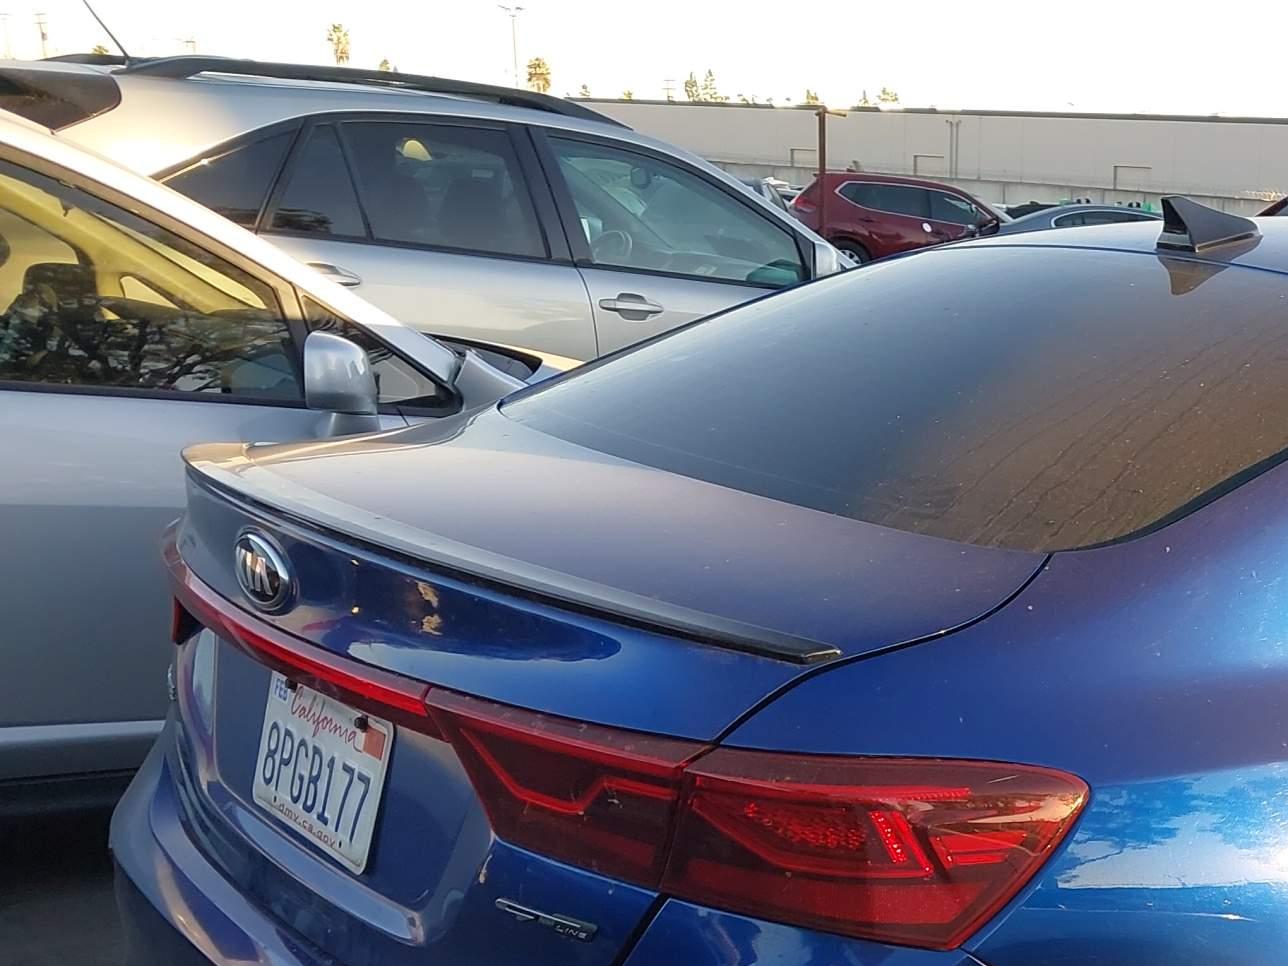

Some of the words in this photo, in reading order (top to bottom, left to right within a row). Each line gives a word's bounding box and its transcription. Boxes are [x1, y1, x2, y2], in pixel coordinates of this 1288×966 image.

[290, 685, 363, 753] California
[263, 722, 371, 843] 8PGB177
[555, 924, 588, 940] LINE
